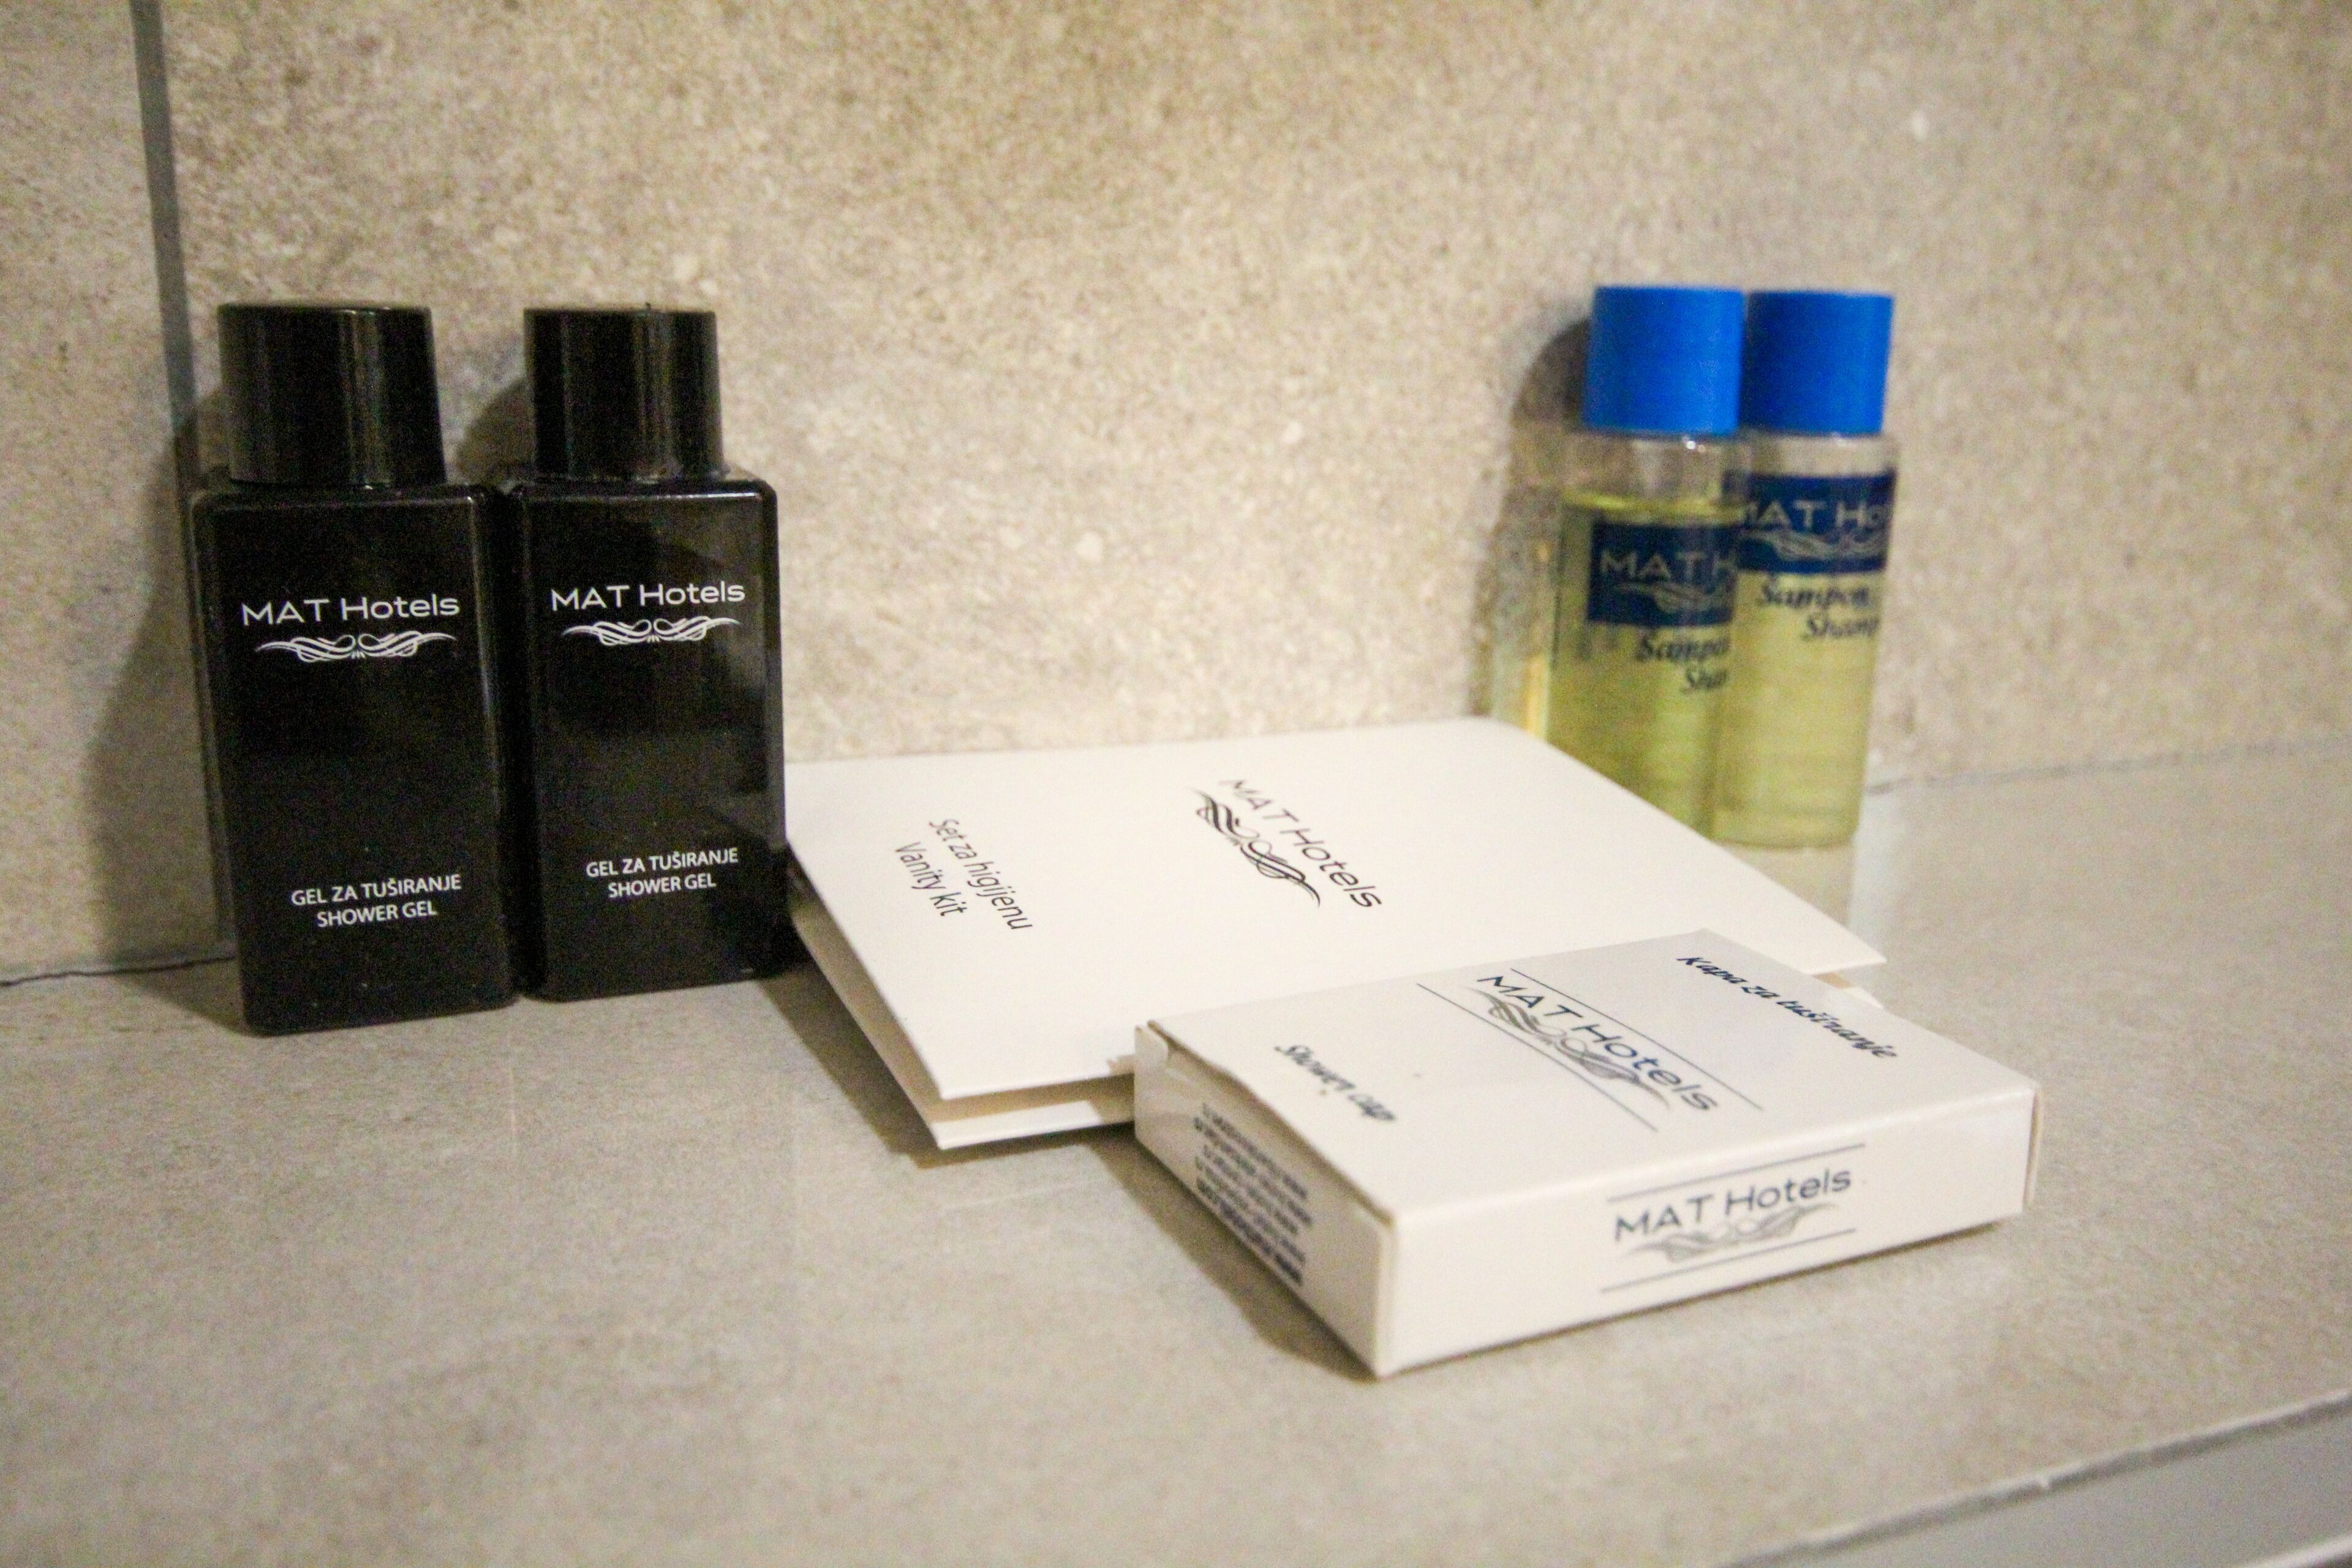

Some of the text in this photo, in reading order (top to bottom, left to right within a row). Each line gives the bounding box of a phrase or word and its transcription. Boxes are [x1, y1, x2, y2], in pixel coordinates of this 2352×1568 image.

[241, 593, 460, 626] MAT Hotels
[551, 580, 745, 611] MAT Hotels
[586, 847, 739, 878] GEL ZA TUŠIRANJE
[1217, 780, 1382, 908] MAT Hotels
[291, 873, 462, 906] GEL ZA TUŠIRANJE
[608, 873, 717, 899] SHOWER GEL
[895, 841, 968, 917] Vanity kit
[928, 818, 1033, 930] Set za higijenu
[317, 900, 438, 928] SHOWER GEL
[1676, 957, 1747, 984] Kapa
[1741, 986, 1780, 998] za
[1476, 976, 1719, 1111] MAT Hotels
[1613, 1169, 1852, 1242] MAT Hotels
